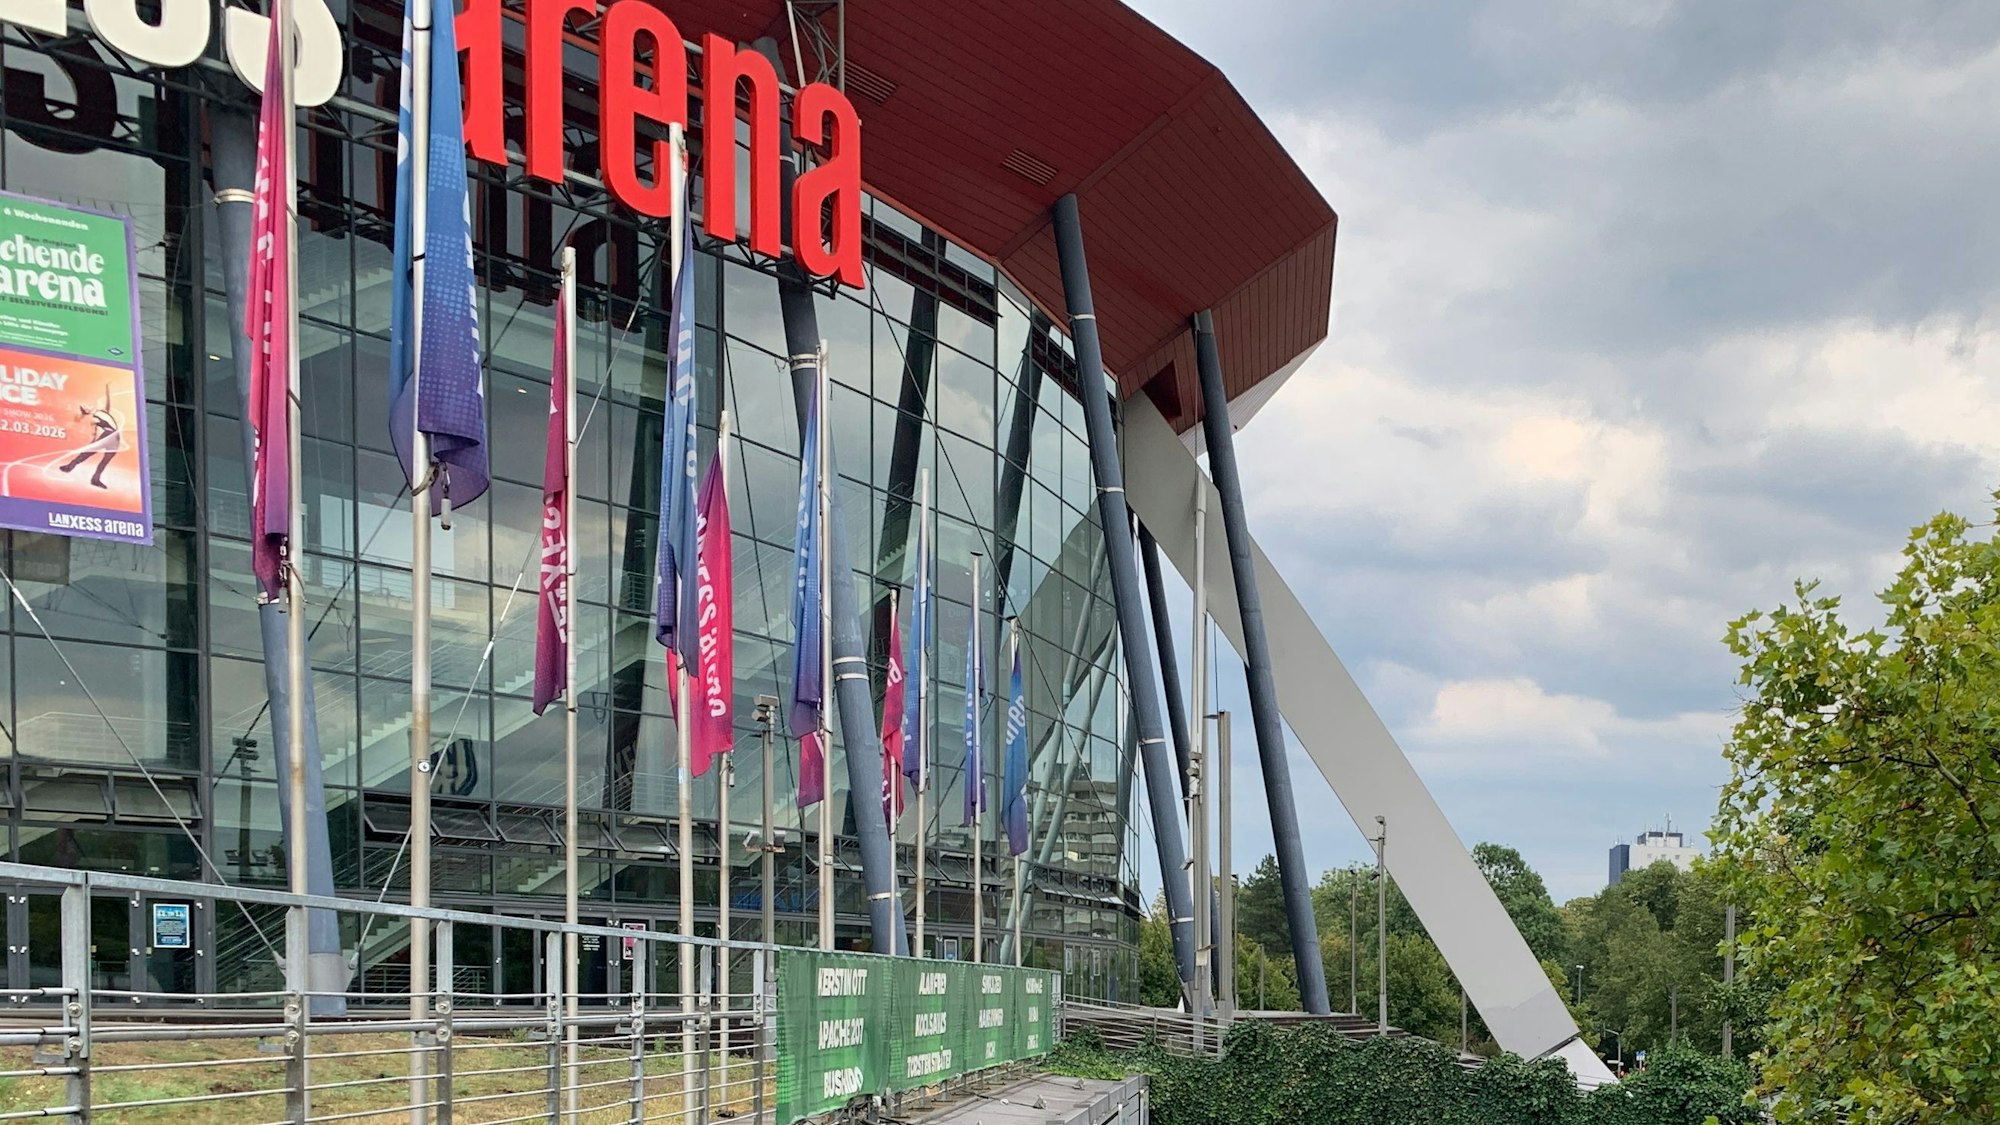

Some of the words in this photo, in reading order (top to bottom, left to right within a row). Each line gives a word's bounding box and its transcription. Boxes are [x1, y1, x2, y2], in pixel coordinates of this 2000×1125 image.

[0, 234, 105, 275] chende
[0, 364, 69, 391] LIDAY
[48, 512, 102, 532] LANXESS
[104, 519, 144, 538] arena
[818, 967, 852, 996] KERSTIN
[818, 1019, 851, 1050] APACHE
[850, 1018, 864, 1045] 207
[824, 1066, 864, 1099] BUSHIDO
